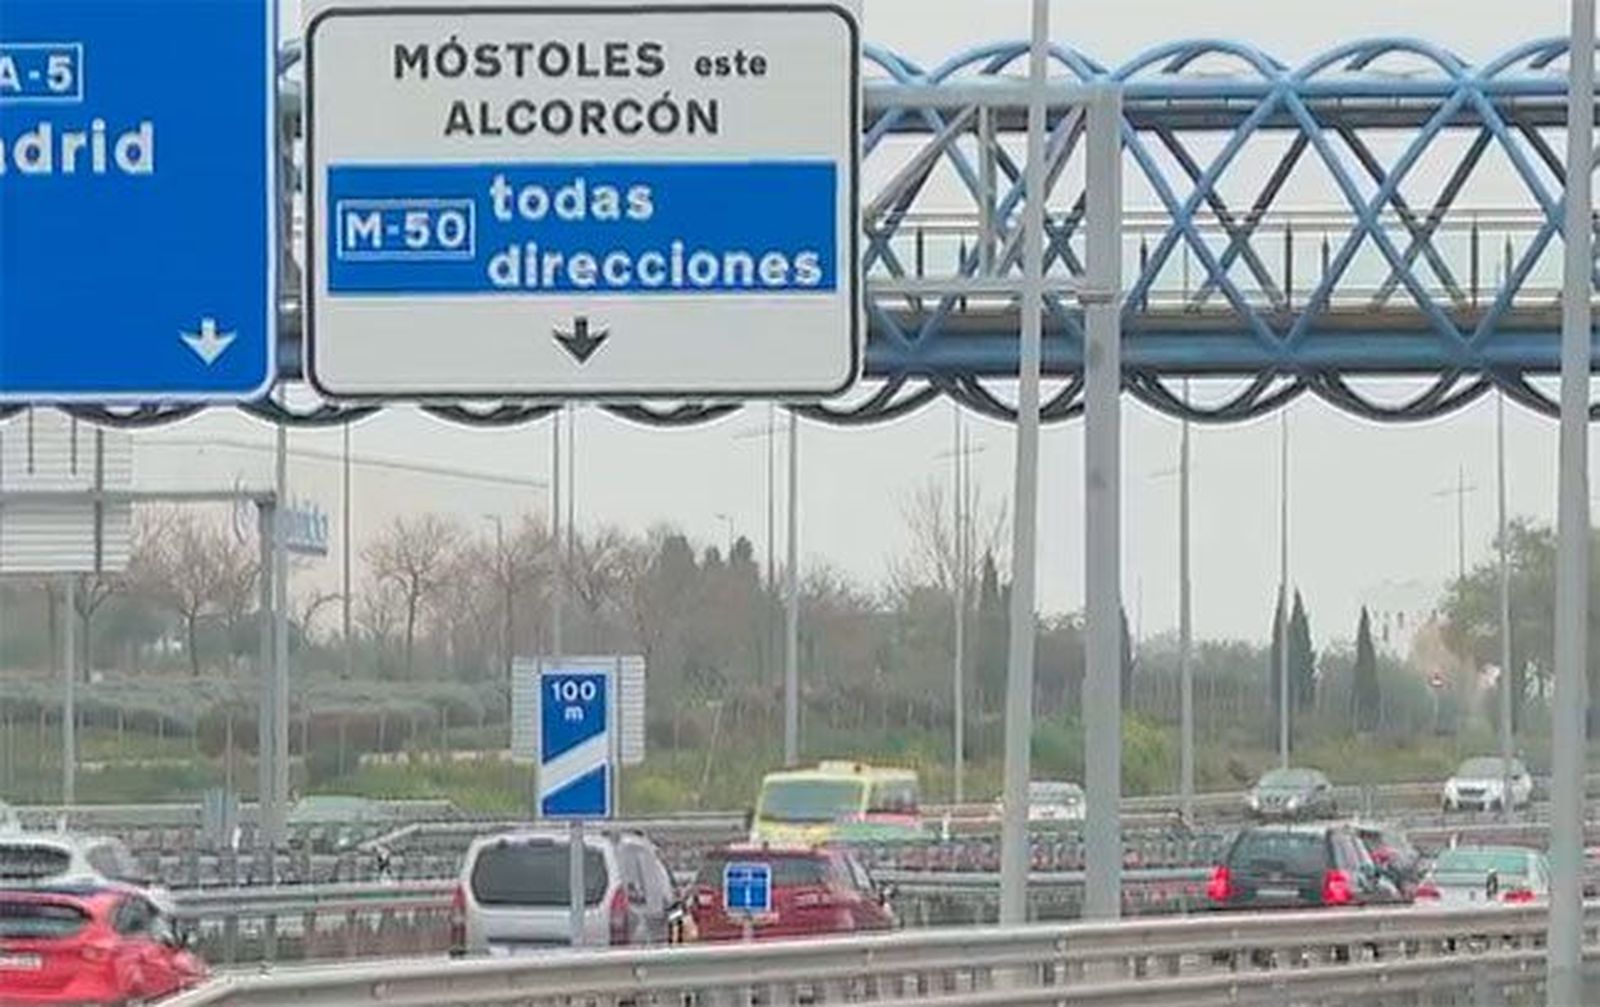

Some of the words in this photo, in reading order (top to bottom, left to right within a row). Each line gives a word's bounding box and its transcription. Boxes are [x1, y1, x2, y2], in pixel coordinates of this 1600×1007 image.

[394, 35, 665, 79] MÓSTOLES
[695, 49, 767, 77] este
[444, 91, 719, 135] ALCORCÓN
[0, 118, 153, 175] drid
[490, 174, 653, 221] todas
[347, 211, 466, 248] M-50
[488, 240, 822, 287] direcciones
[552, 681, 596, 701] 100
[565, 706, 583, 720] m
